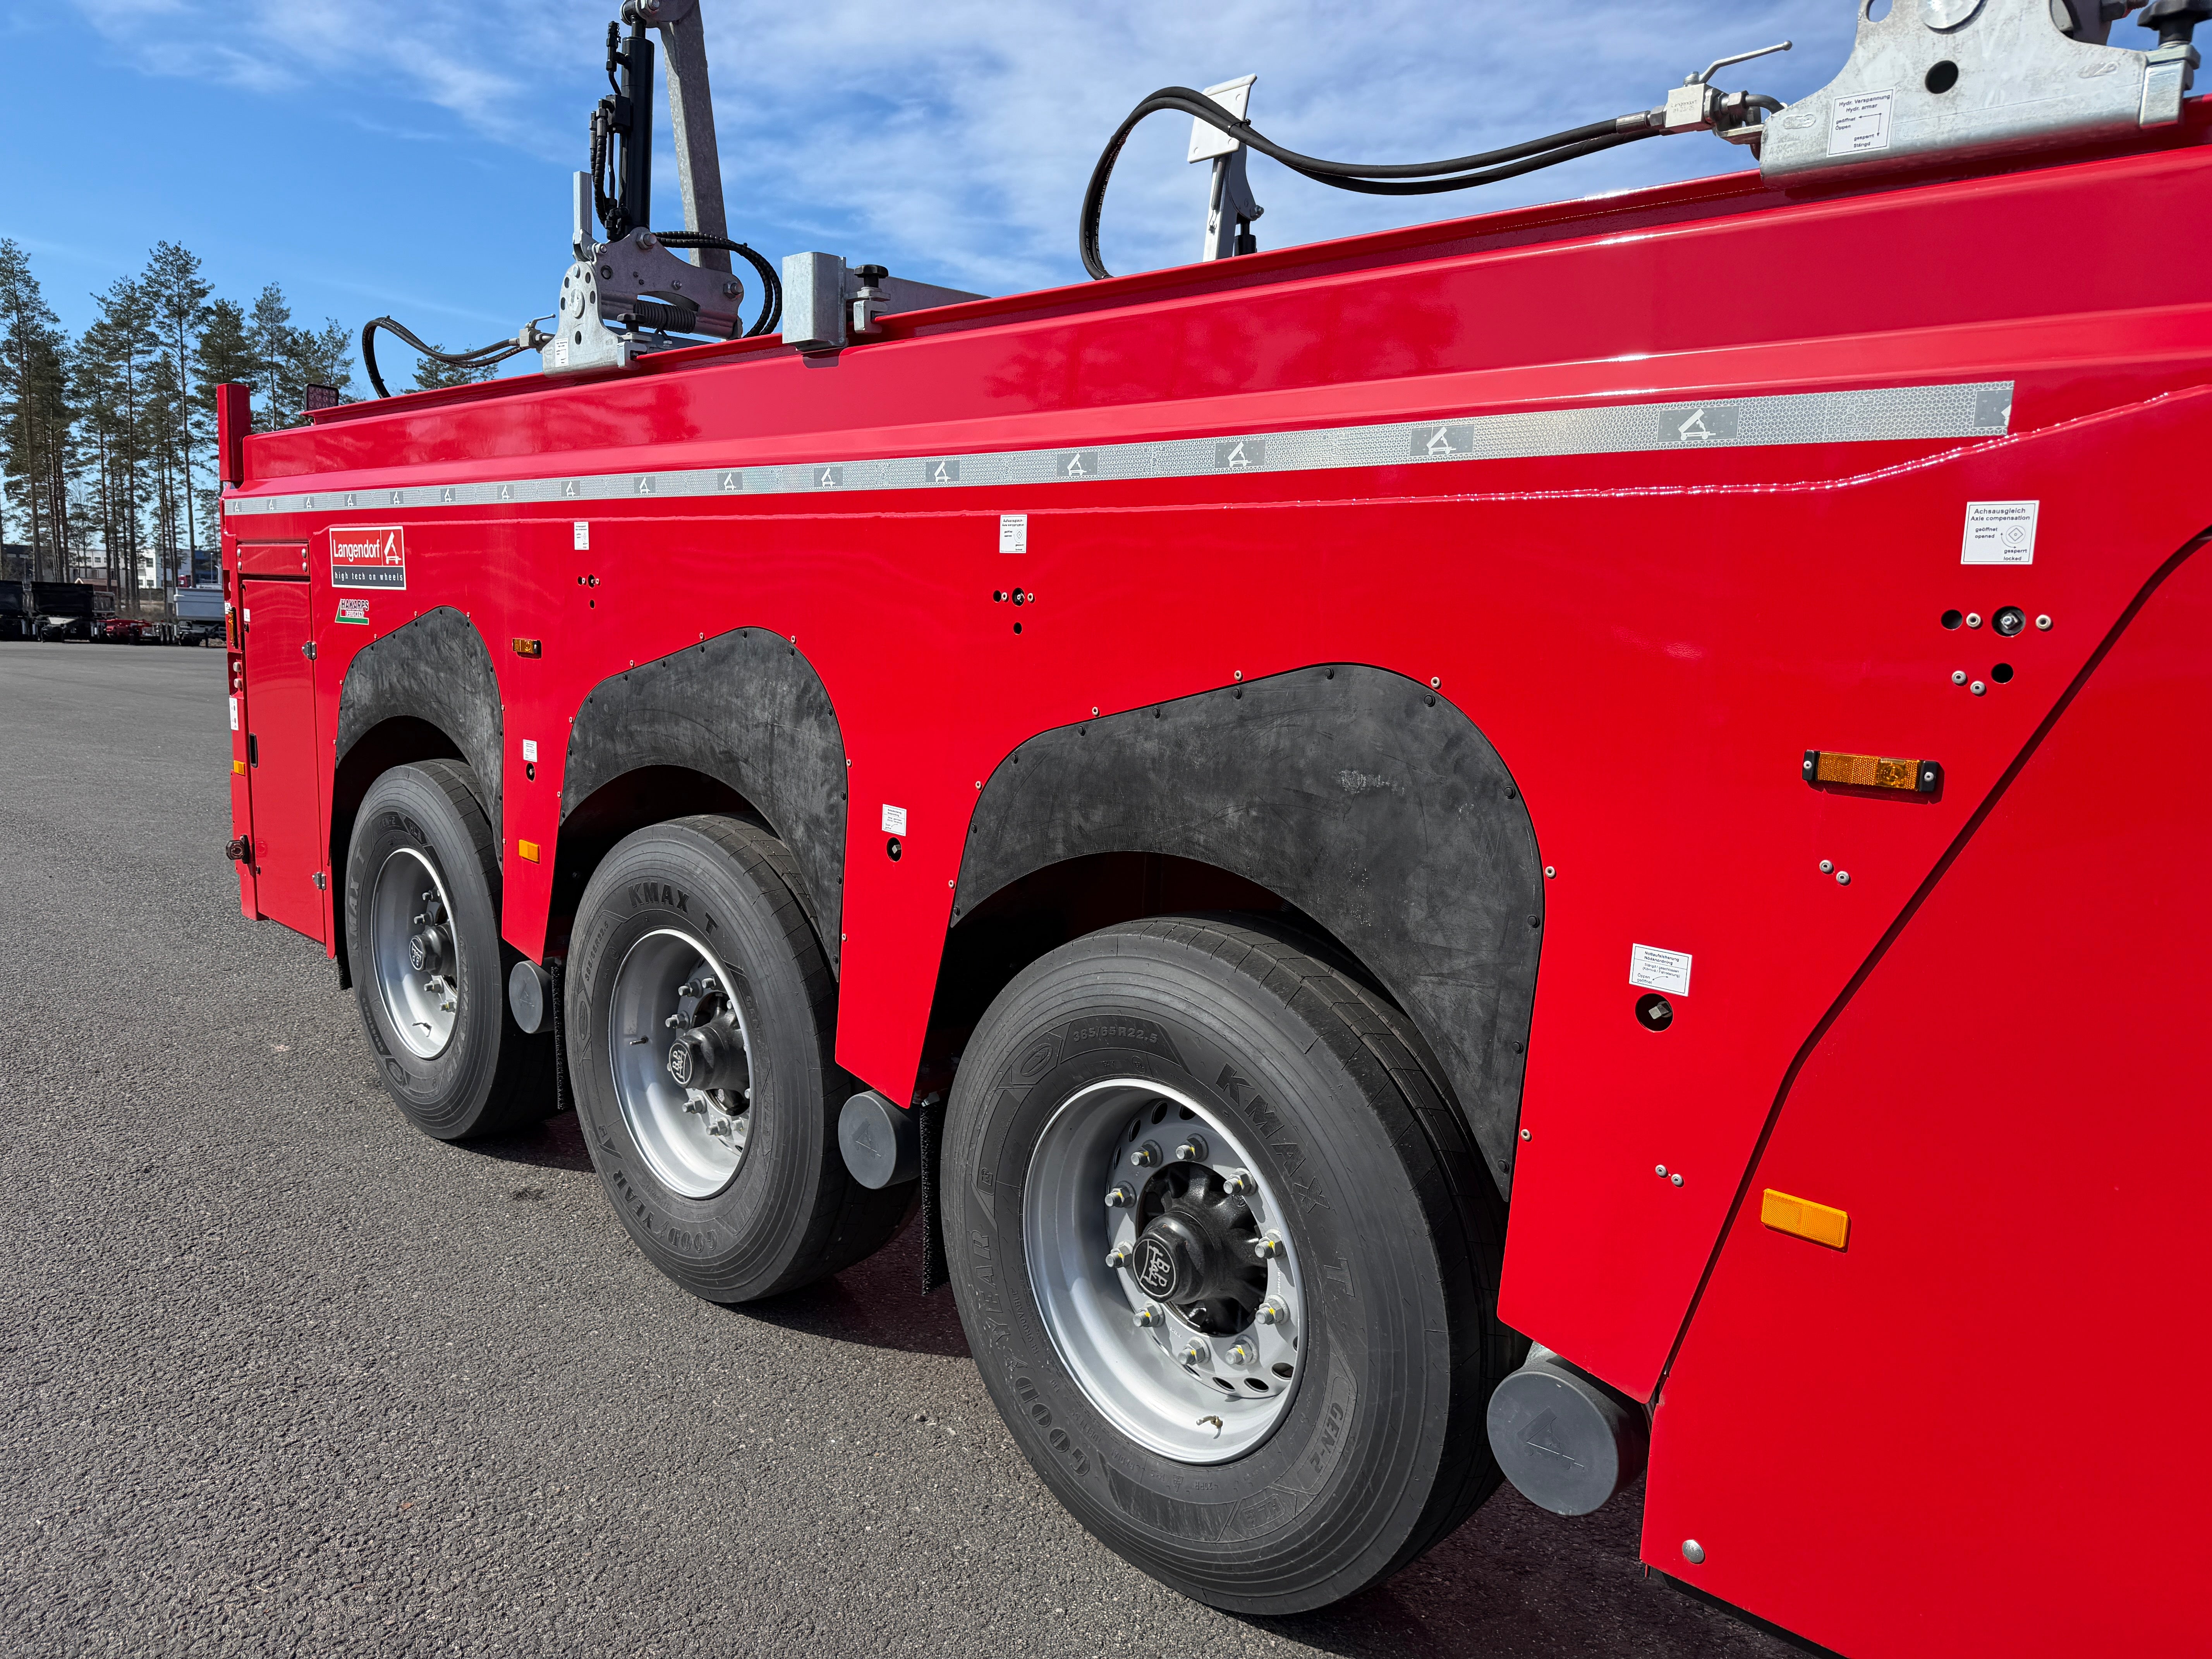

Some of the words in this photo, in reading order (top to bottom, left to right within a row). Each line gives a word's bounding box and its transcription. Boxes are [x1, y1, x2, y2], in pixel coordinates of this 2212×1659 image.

[1855, 94, 1890, 103] Verspannung
[333, 539, 380, 562] Langendorf
[335, 572, 348, 581] high
[380, 573, 403, 581] wheels
[628, 881, 690, 914] KMAX
[704, 912, 719, 936] T
[1073, 1025, 1158, 1044] 385/65R22.5
[1215, 1063, 1330, 1213] KMAX
[1324, 1257, 1355, 1298] T
[612, 1169, 718, 1253] GOODYEAR
[971, 1228, 1091, 1477] GOODYEAR
[1310, 1402, 1343, 1474] GEN-2
